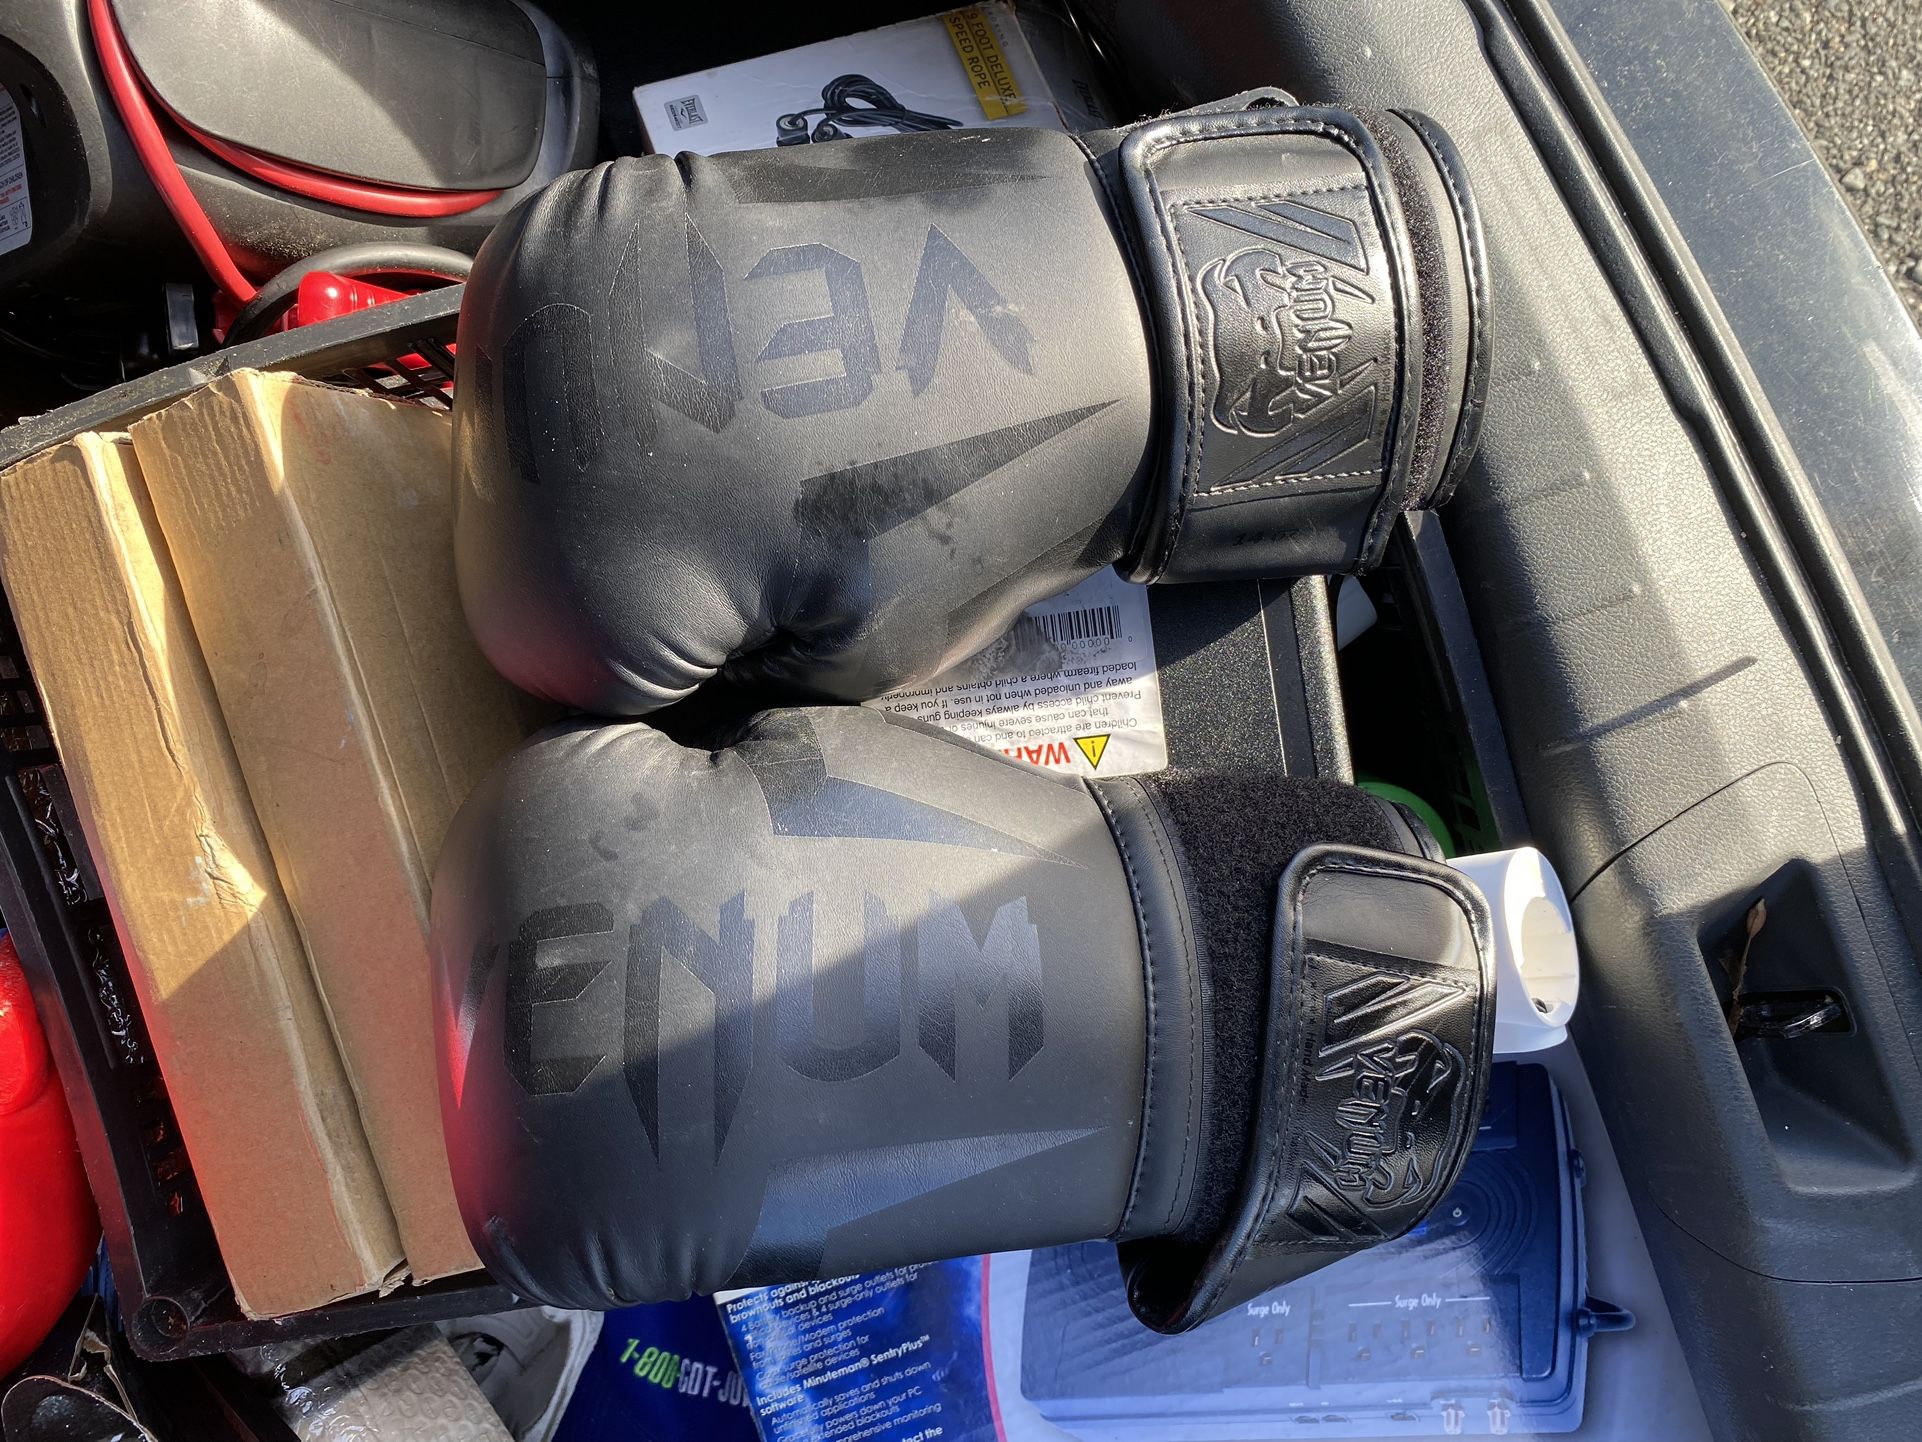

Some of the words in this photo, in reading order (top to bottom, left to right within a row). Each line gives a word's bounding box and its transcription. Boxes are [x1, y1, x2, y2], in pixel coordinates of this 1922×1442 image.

[966, 10, 979, 21] 9
[970, 19, 995, 54] FOOT
[947, 14, 975, 55] SPEED
[965, 53, 991, 90] ROPE
[984, 51, 1018, 103] DELUXE
[1268, 261, 1353, 418] VENUM
[1063, 664, 1100, 680] firearm
[1101, 659, 1137, 675] loaded
[993, 675, 1019, 689] child
[1020, 674, 1028, 683] a
[1029, 669, 1062, 684] where
[1082, 678, 1103, 691] and
[1104, 672, 1133, 687] away
[985, 691, 1002, 703] not
[1003, 687, 1032, 701] when
[1033, 680, 1081, 698] unloaded
[1100, 687, 1142, 704] Prevent
[893, 700, 919, 715] keep
[919, 698, 939, 711] you
[940, 698, 948, 709] If
[949, 694, 972, 706] use.
[974, 694, 984, 705] in
[1021, 699, 1035, 713] by
[1036, 696, 1073, 710] access
[1074, 693, 1099, 707] child
[943, 705, 983, 723] keeping
[984, 701, 1020, 718] always
[1033, 710, 1065, 723] cause
[1067, 708, 1087, 719] can
[1087, 704, 1109, 718] that
[960, 718, 996, 733] injuries
[997, 714, 1032, 728] severe
[1074, 721, 1092, 732] are
[1093, 715, 1138, 732] Children
[973, 733, 993, 744] can
[994, 730, 1013, 743] and
[1015, 728, 1026, 740] to
[1028, 722, 1073, 739] attracted
[434, 888, 1046, 1172] VENUM
[1302, 1032, 1316, 1067] Hand
[783, 1299, 816, 1317] backup
[819, 1292, 836, 1303] and
[840, 1284, 862, 1297] surge
[865, 1271, 893, 1287] outlets
[894, 1264, 909, 1276] for
[811, 1307, 819, 1316] &
[829, 1288, 874, 1310] surge-only
[876, 1277, 904, 1293] outlets
[904, 1270, 918, 1282] for
[728, 1292, 768, 1312] Protects
[731, 1297, 783, 1322] brownouts
[786, 1289, 805, 1302] and
[1247, 1303, 1269, 1318] Surge
[1271, 1301, 1291, 1317] Only
[1394, 1295, 1419, 1311] Surge
[1420, 1293, 1442, 1309] Only
[799, 1312, 832, 1330] devices
[838, 1306, 885, 1329] protection
[804, 1338, 821, 1350] and
[824, 1328, 852, 1344] surges
[810, 1340, 855, 1362] protection
[855, 1333, 871, 1345] for
[825, 1348, 859, 1365] devices
[758, 1384, 801, 1405] Includes
[772, 1397, 832, 1424] Automatically
[835, 1388, 859, 1401] saves
[862, 1379, 879, 1391] and
[881, 1371, 903, 1384] shuts
[906, 1361, 930, 1375] down
[761, 1393, 804, 1415] software
[821, 1391, 875, 1416] applications
[826, 1411, 857, 1428] powers
[860, 1400, 885, 1414] down
[887, 1392, 908, 1406] your
[907, 1385, 922, 1397] PC
[857, 1405, 899, 1425] blackouts
[894, 1403, 942, 1426] monitoring
[926, 1425, 942, 1438] the
